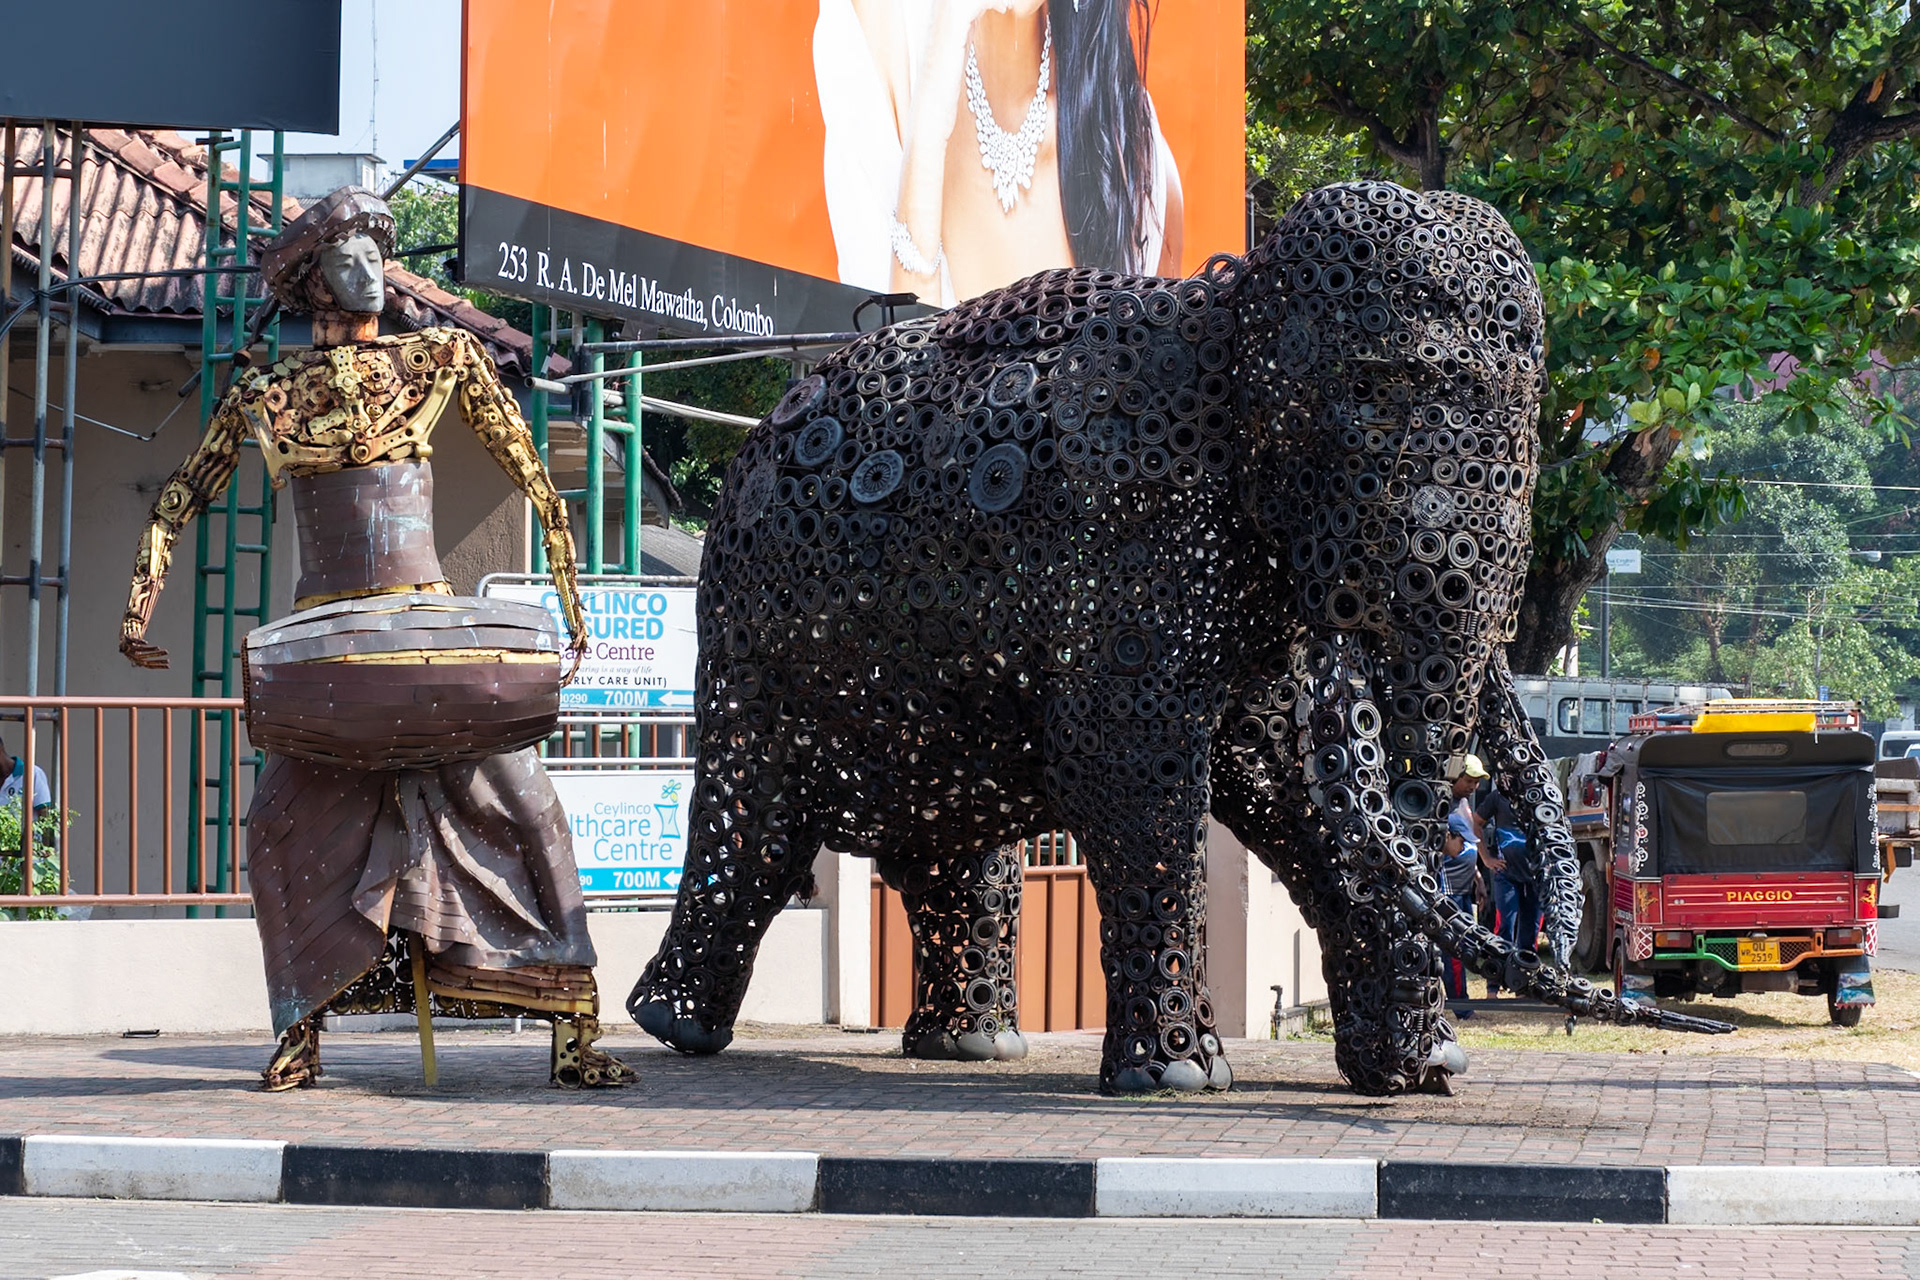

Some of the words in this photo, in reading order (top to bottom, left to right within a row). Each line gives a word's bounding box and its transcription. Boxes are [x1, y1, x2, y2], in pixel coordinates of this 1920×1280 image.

[497, 241, 528, 283] 253
[536, 250, 555, 290] R.
[558, 257, 578, 294] A.
[581, 262, 605, 300] De
[608, 268, 637, 308] Mel
[640, 276, 709, 331] Mawatha,
[711, 294, 774, 337] Colombo
[540, 591, 668, 616] CLINCO
[559, 642, 593, 660] Cae
[595, 642, 655, 660] Centre
[598, 676, 629, 686] CARE
[634, 676, 668, 688] UNIT)
[560, 692, 588, 704] 0290
[603, 690, 649, 707] 700M
[593, 802, 652, 817] Ceylinco
[593, 838, 673, 861] Centre
[613, 870, 661, 889] 700M
[1726, 890, 1793, 902] PIAGGIO
